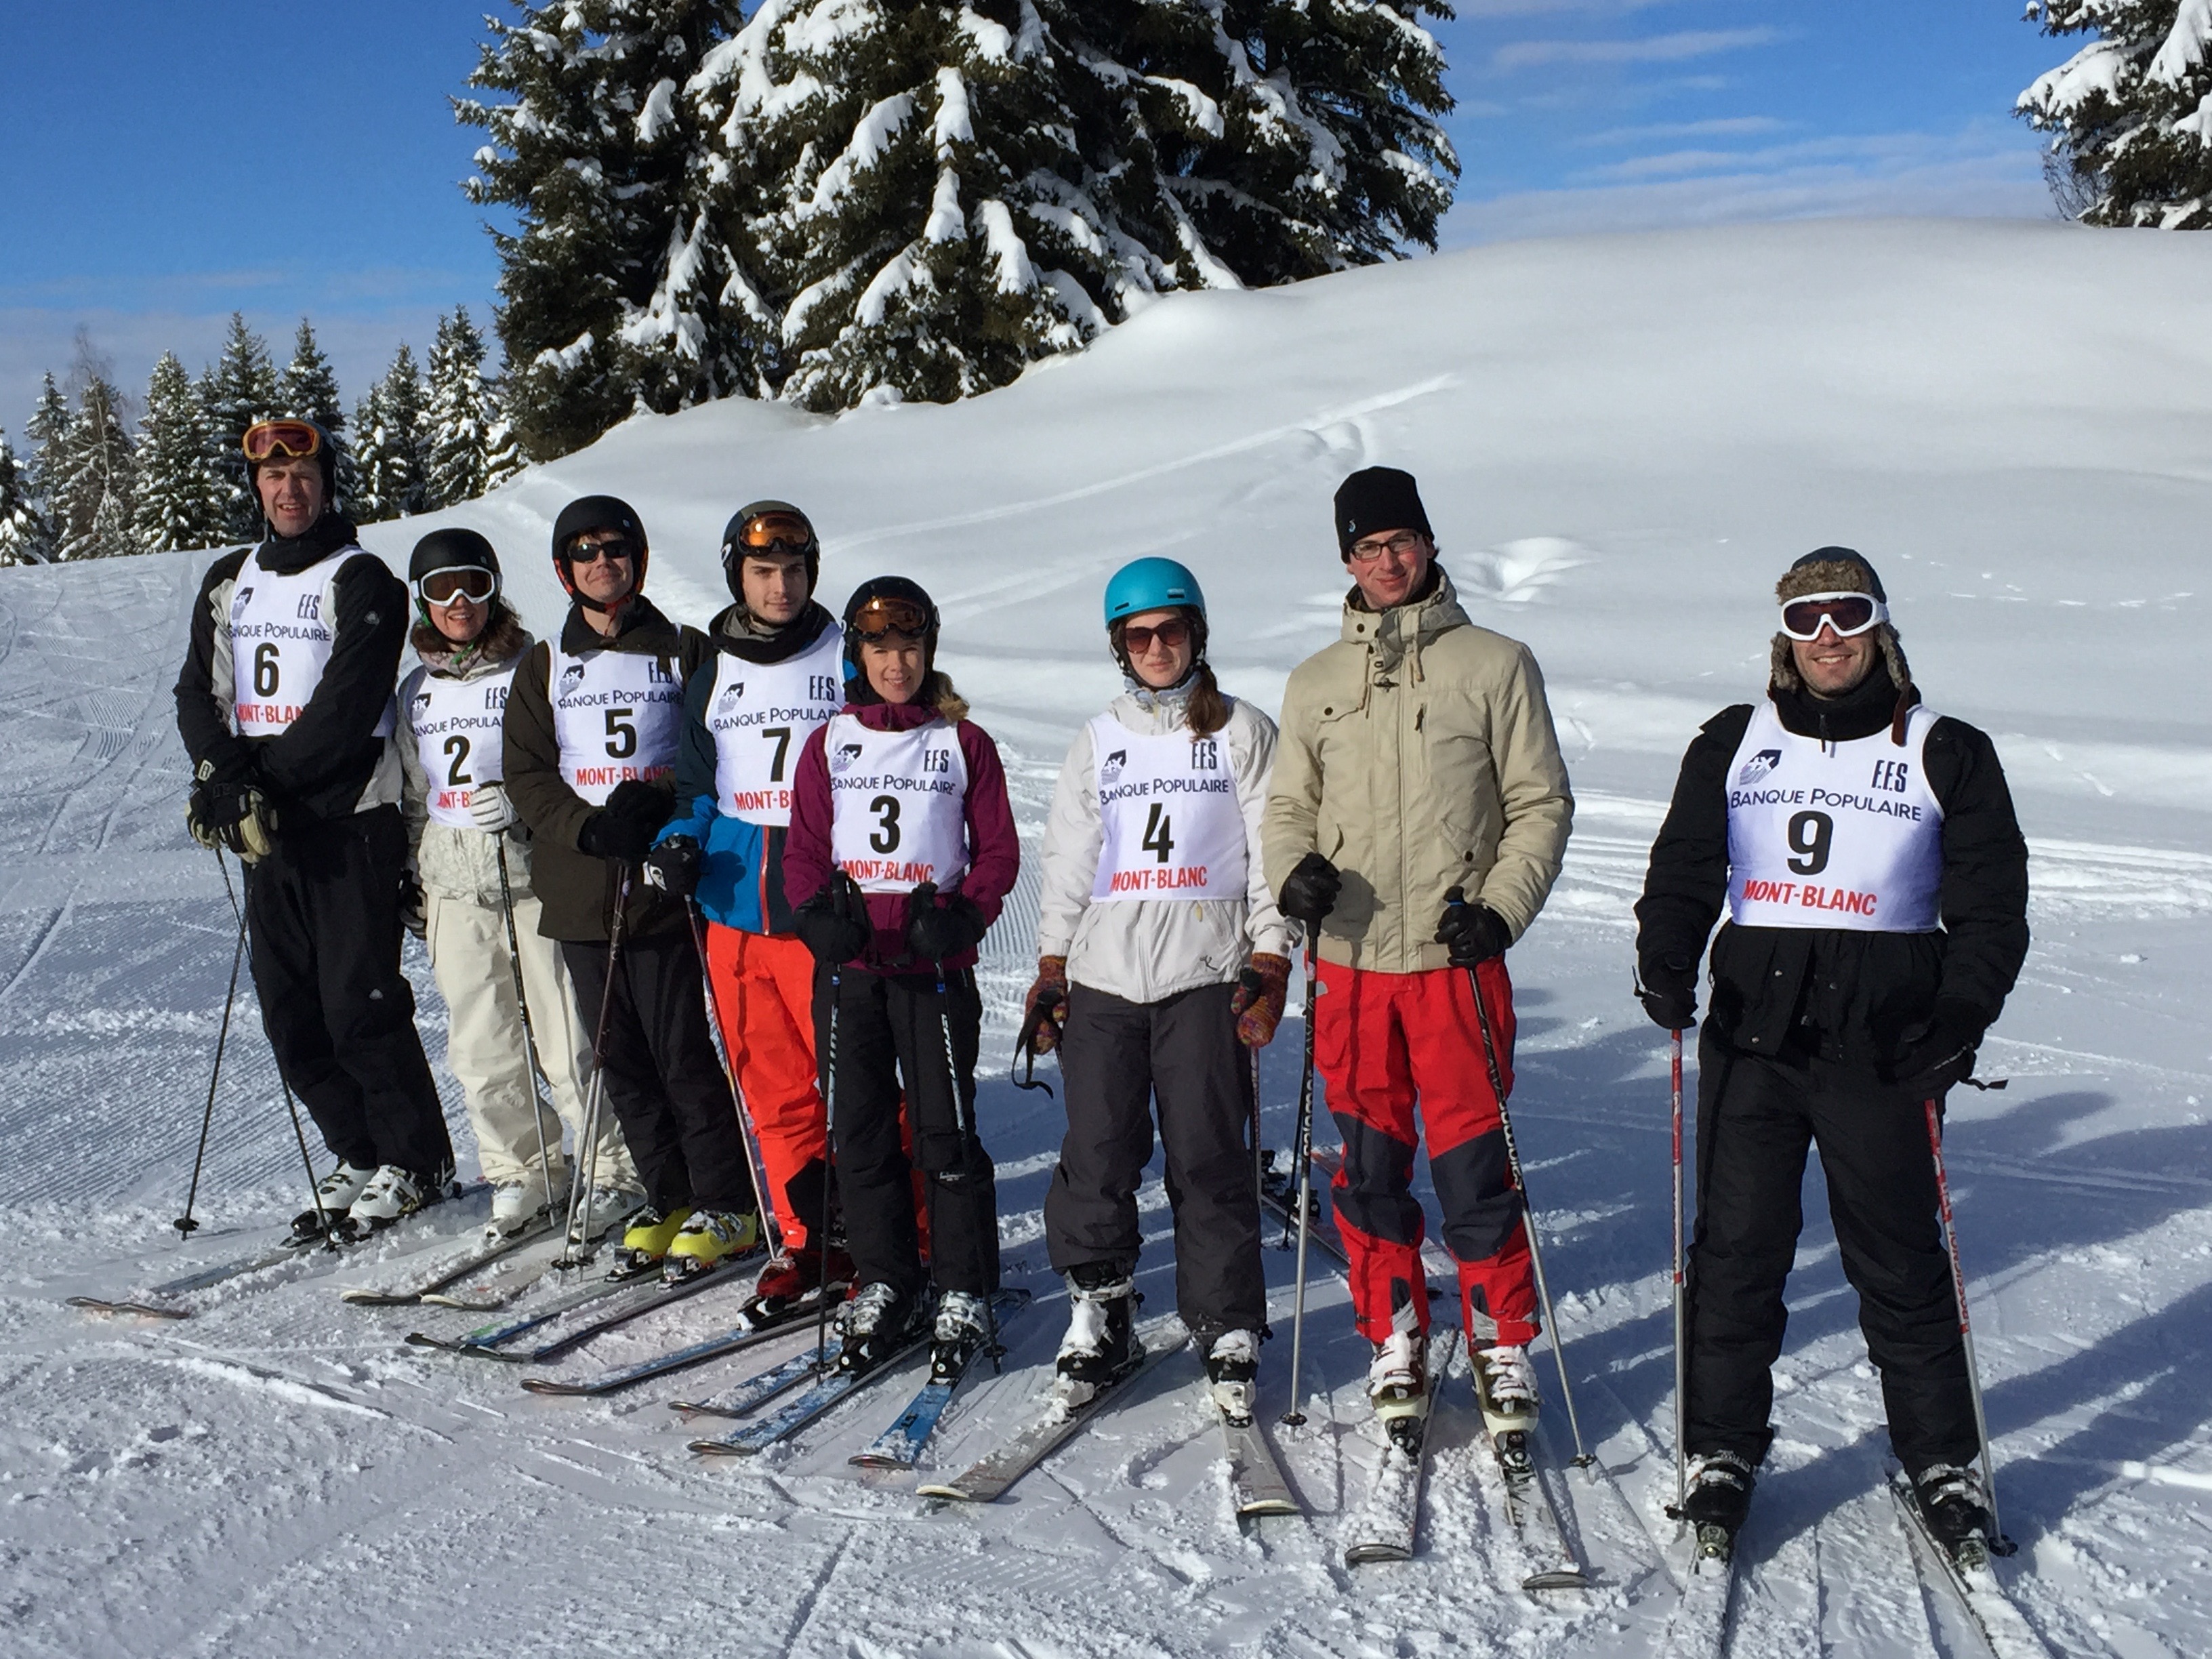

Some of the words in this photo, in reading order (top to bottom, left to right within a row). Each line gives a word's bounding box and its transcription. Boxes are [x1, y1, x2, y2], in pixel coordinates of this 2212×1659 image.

[265, 622, 331, 641] POPULAIRE
[253, 642, 280, 697] 6
[605, 708, 636, 759] 5
[714, 712, 766, 731] BANQUE
[444, 735, 472, 787] 2
[762, 726, 791, 782] 7
[883, 775, 956, 796] POPULAIRE
[1099, 781, 1150, 805] BANQUE
[1153, 778, 1229, 795] POPULAIRE
[1731, 789, 1805, 808] BANQUE
[1809, 788, 1921, 822] POPULAIRE
[869, 795, 901, 854] 3
[1142, 802, 1174, 863] 4
[1786, 810, 1835, 876] 9
[1109, 865, 1208, 893] MONT-BLANC
[1742, 879, 1878, 916] MONT-BLANC
